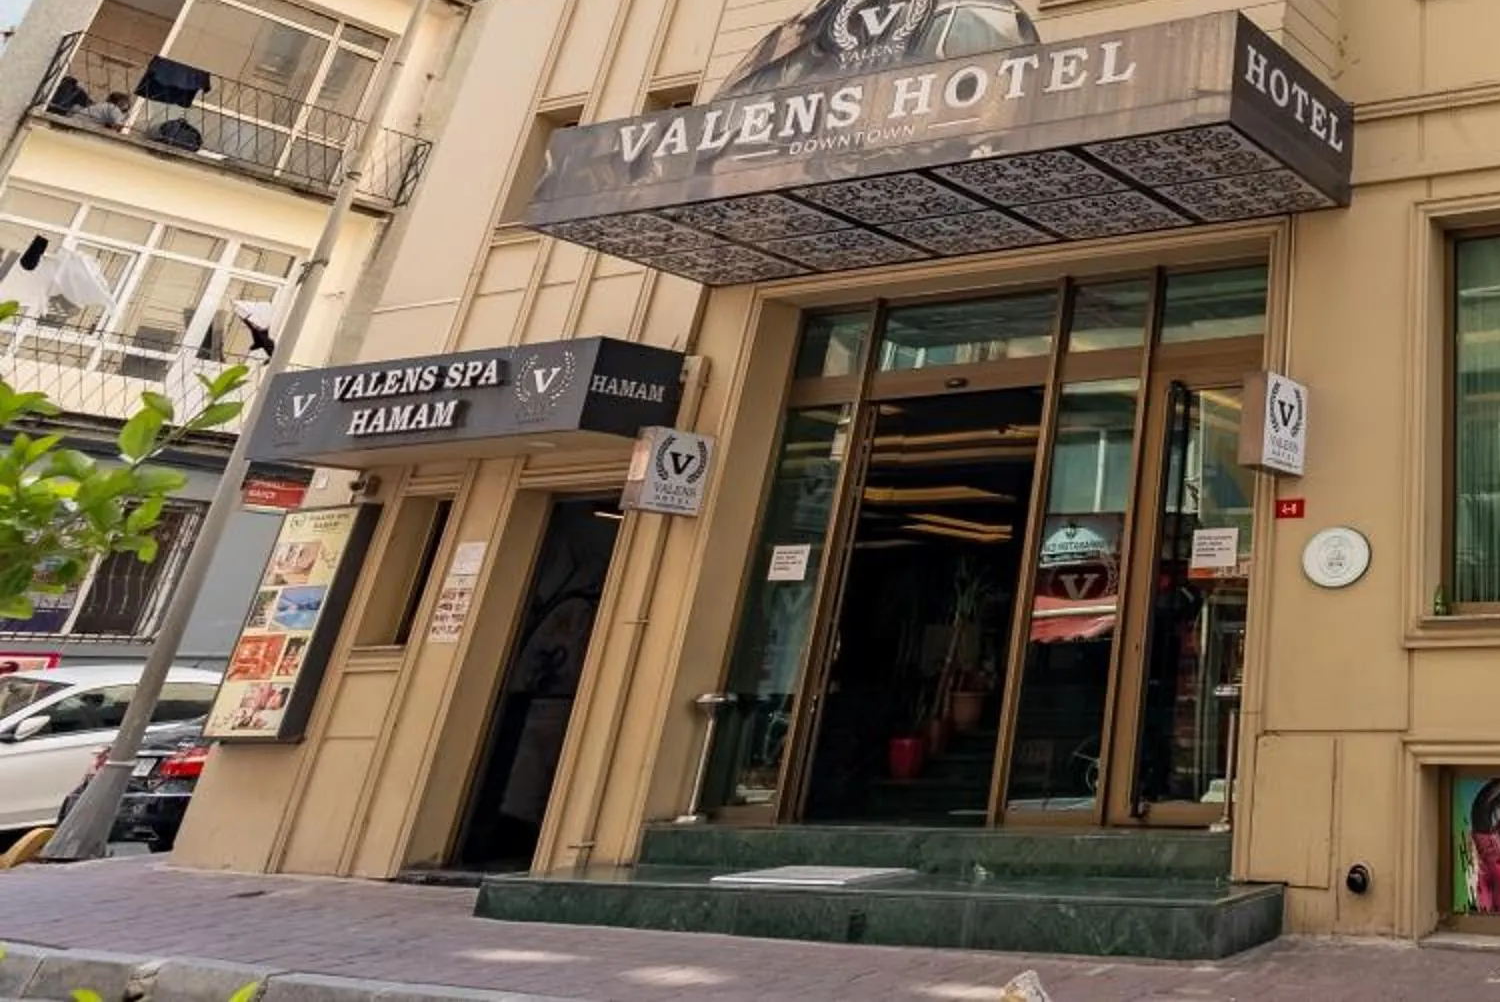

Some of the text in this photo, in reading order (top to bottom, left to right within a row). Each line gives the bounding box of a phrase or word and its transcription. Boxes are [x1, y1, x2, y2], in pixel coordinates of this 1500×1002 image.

[858, 1, 906, 35] V
[619, 41, 1137, 163] VALENS HOTEL
[1245, 44, 1343, 153] HOTEL
[788, 125, 916, 156] DOWNTOWN
[331, 358, 500, 401] VALENS SPA
[533, 367, 562, 394] V
[589, 373, 667, 403] HAMAM
[292, 394, 317, 419] V
[345, 400, 459, 436] HAMAM
[1277, 400, 1295, 427] V
[669, 451, 696, 475] V
